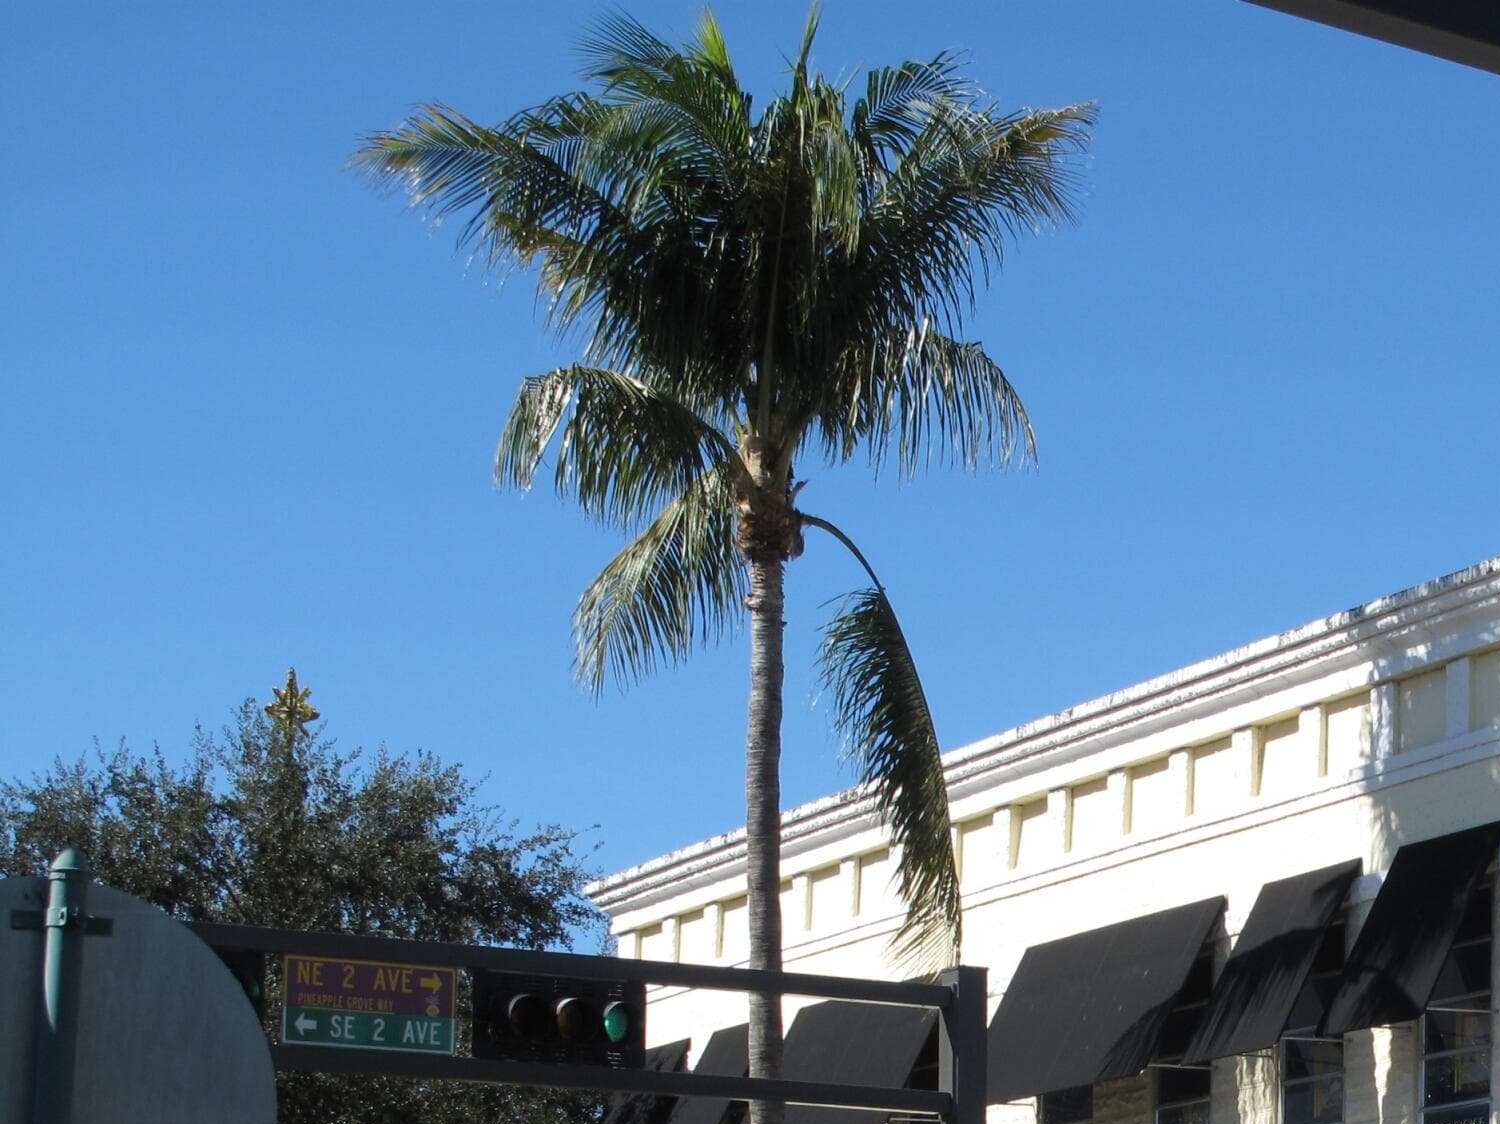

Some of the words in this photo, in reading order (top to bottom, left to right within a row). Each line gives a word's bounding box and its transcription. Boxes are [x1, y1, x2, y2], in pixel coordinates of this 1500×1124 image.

[297, 961, 324, 986] NE
[343, 965, 356, 989] 2
[373, 968, 414, 993] AVE
[298, 992, 343, 1009] PINEAPPLE
[345, 996, 373, 1010] GROVE
[378, 998, 394, 1011] WAY
[329, 1015, 356, 1040] SE
[372, 1018, 386, 1042] 2
[402, 1020, 441, 1046] AVE
